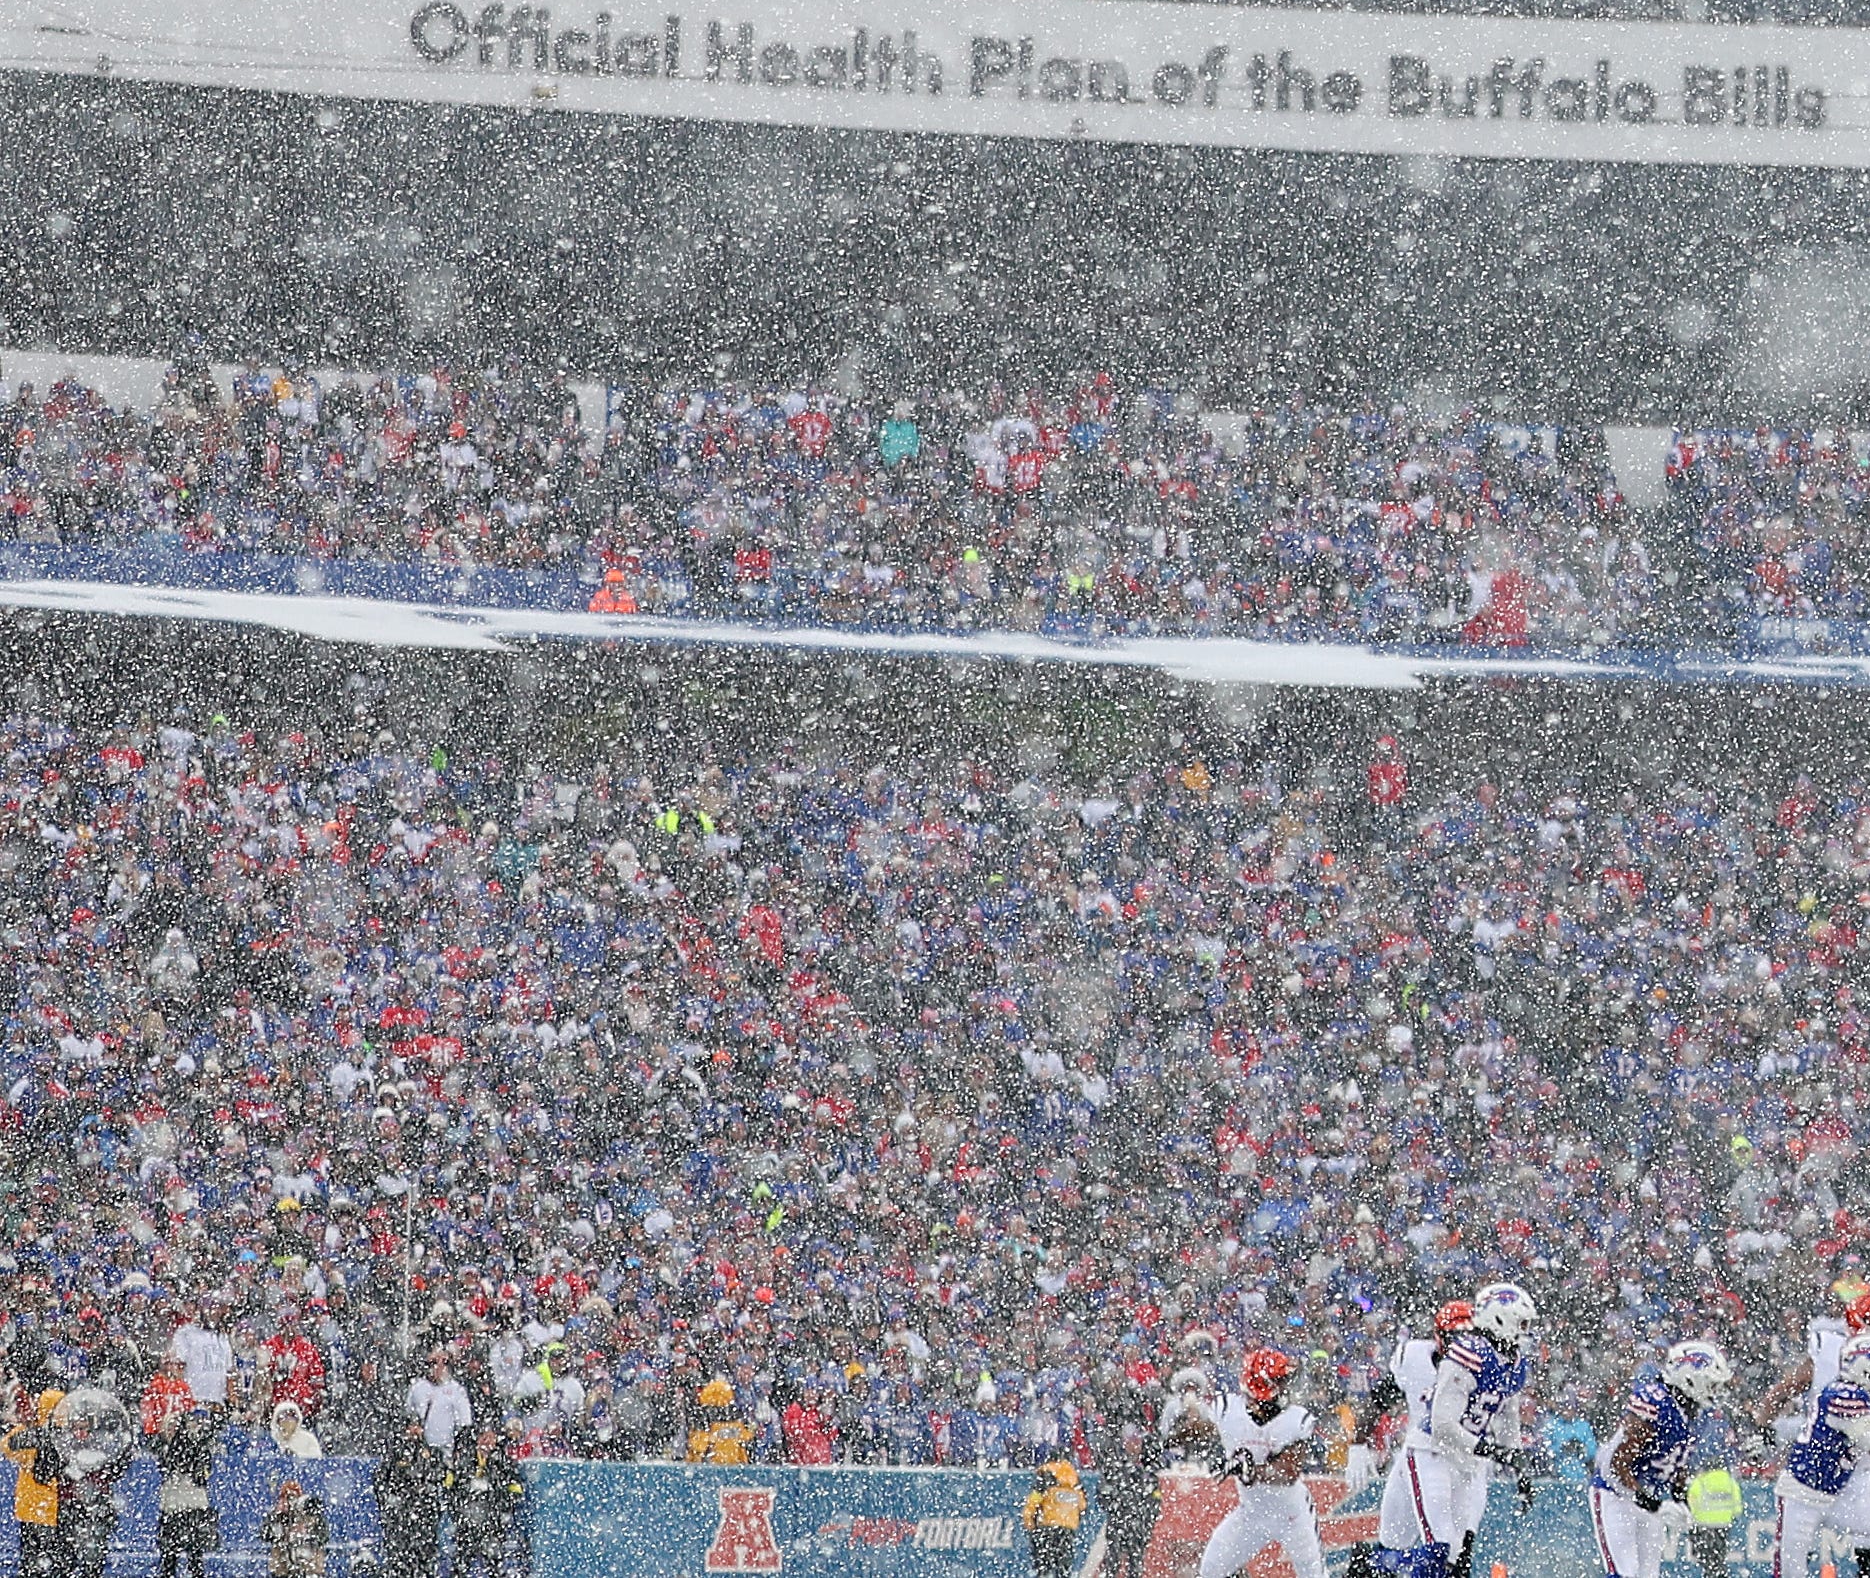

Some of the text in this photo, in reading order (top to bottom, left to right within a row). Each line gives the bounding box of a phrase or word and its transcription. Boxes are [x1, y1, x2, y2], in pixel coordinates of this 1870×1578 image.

[409, 0, 1827, 130] Official Health Plan of the Buffalo Bills
